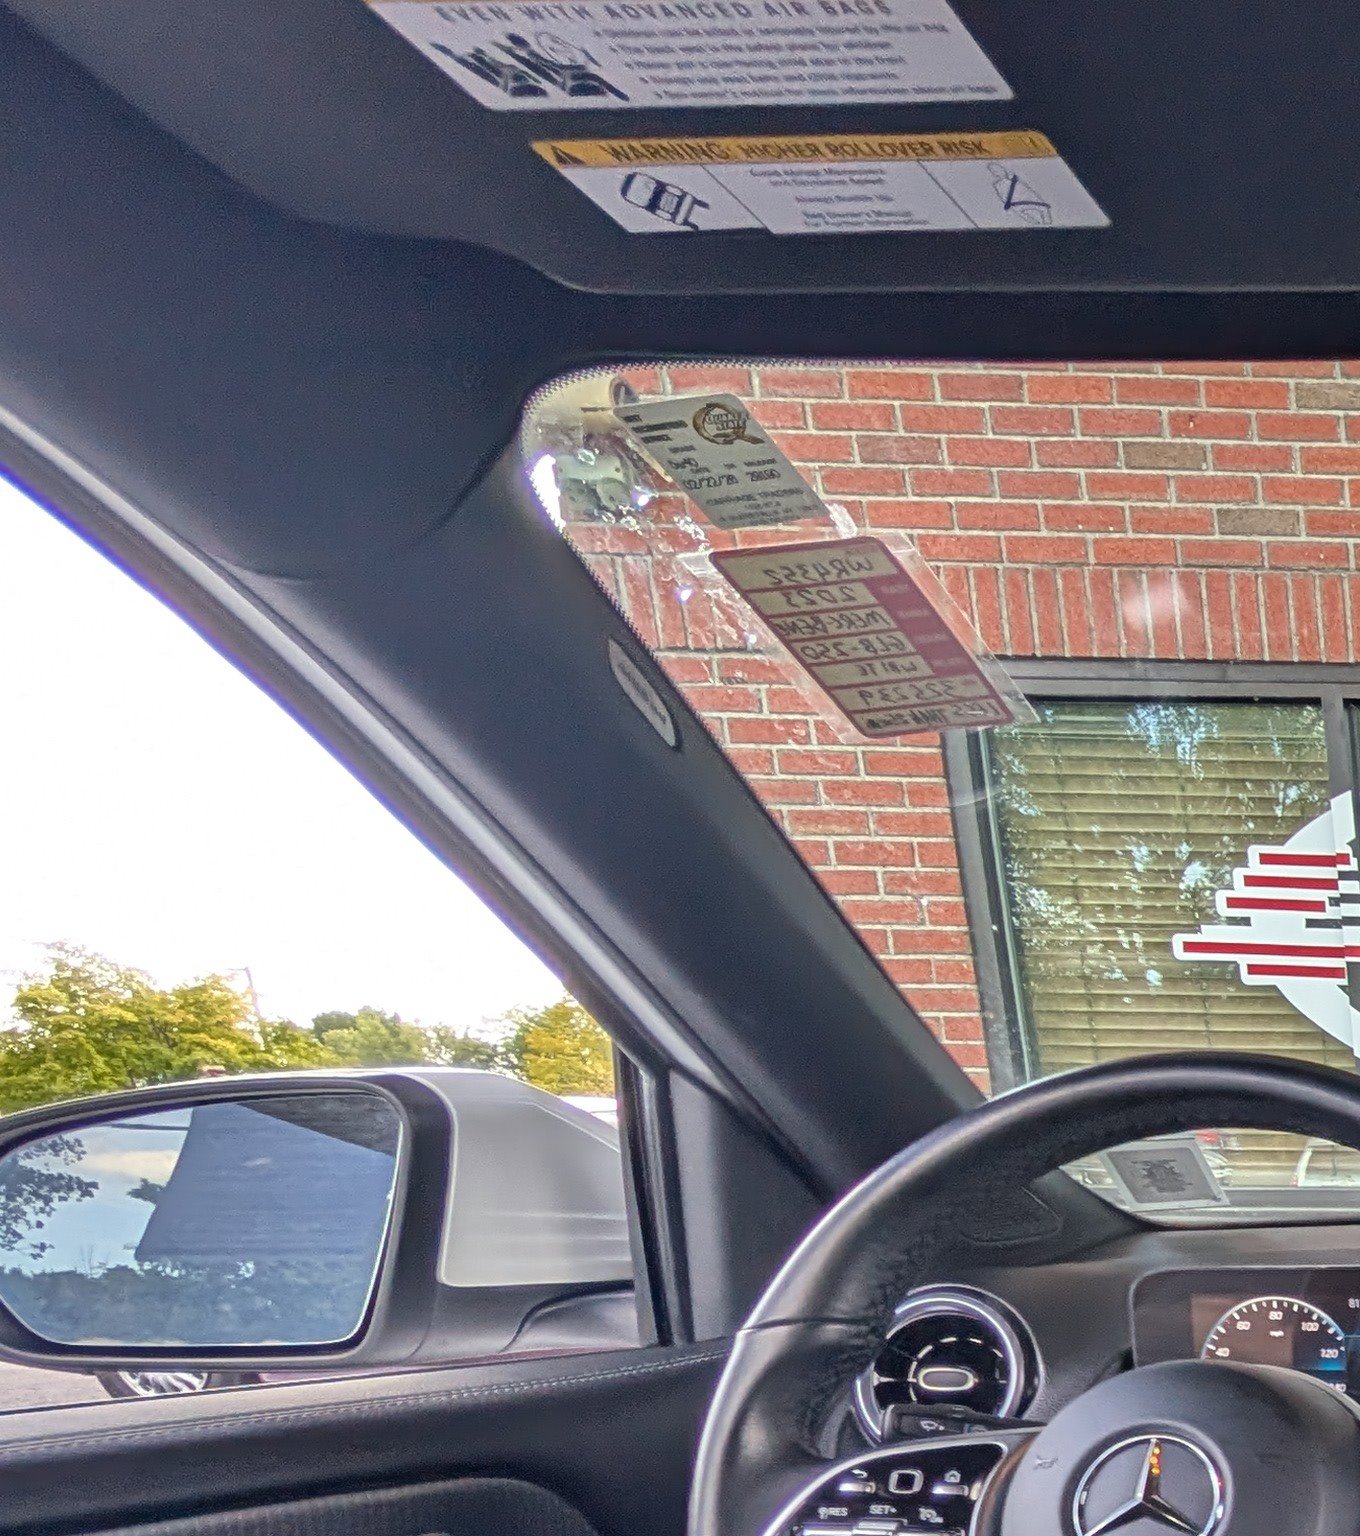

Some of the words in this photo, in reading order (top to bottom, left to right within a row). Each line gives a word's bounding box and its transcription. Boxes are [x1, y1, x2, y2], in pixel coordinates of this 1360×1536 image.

[739, 142, 822, 159] HIGHER
[824, 141, 935, 158] ROLLOVER
[937, 140, 991, 155] RISK
